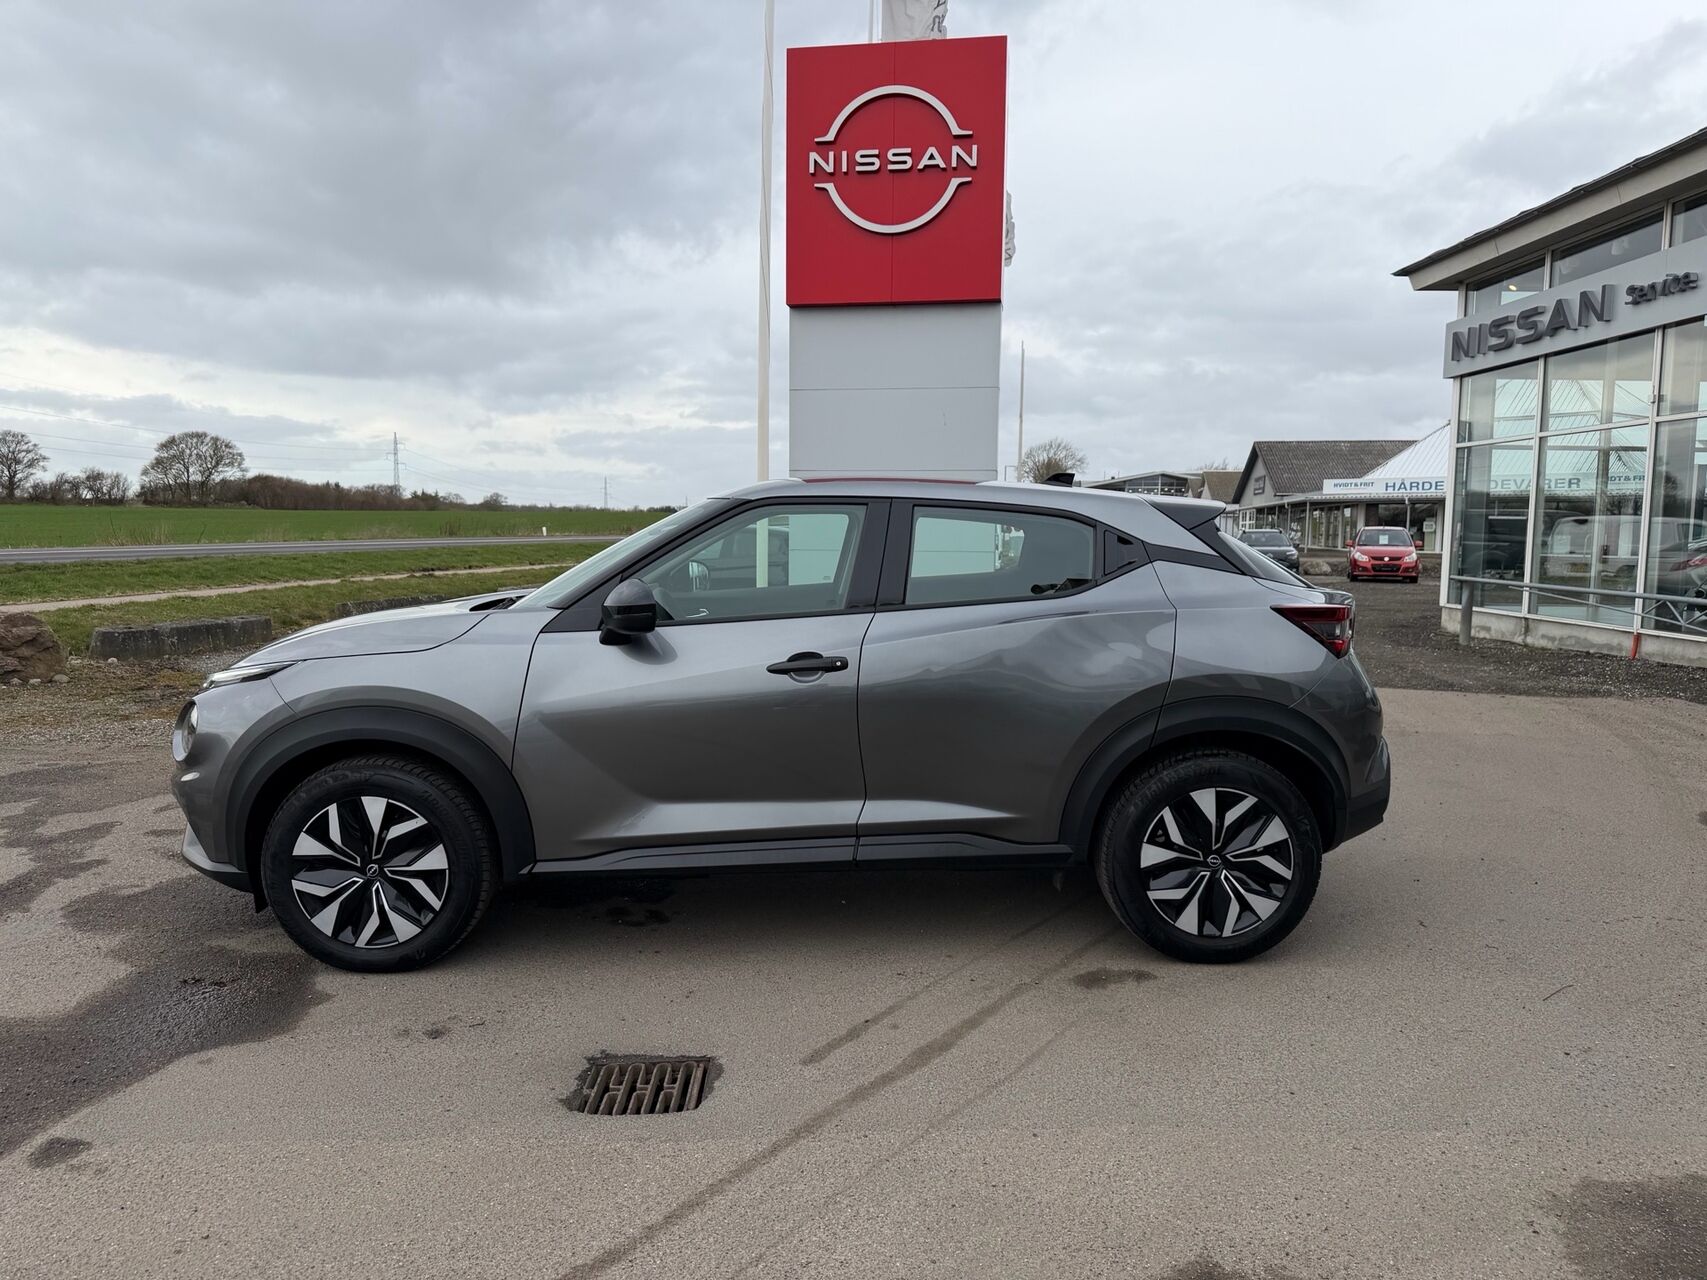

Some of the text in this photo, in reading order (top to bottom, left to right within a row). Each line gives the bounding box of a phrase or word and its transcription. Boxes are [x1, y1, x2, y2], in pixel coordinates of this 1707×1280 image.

[808, 144, 978, 175] NISSAN
[1451, 284, 1615, 362] NISSAN
[1385, 478, 1445, 491] HÅRDE
